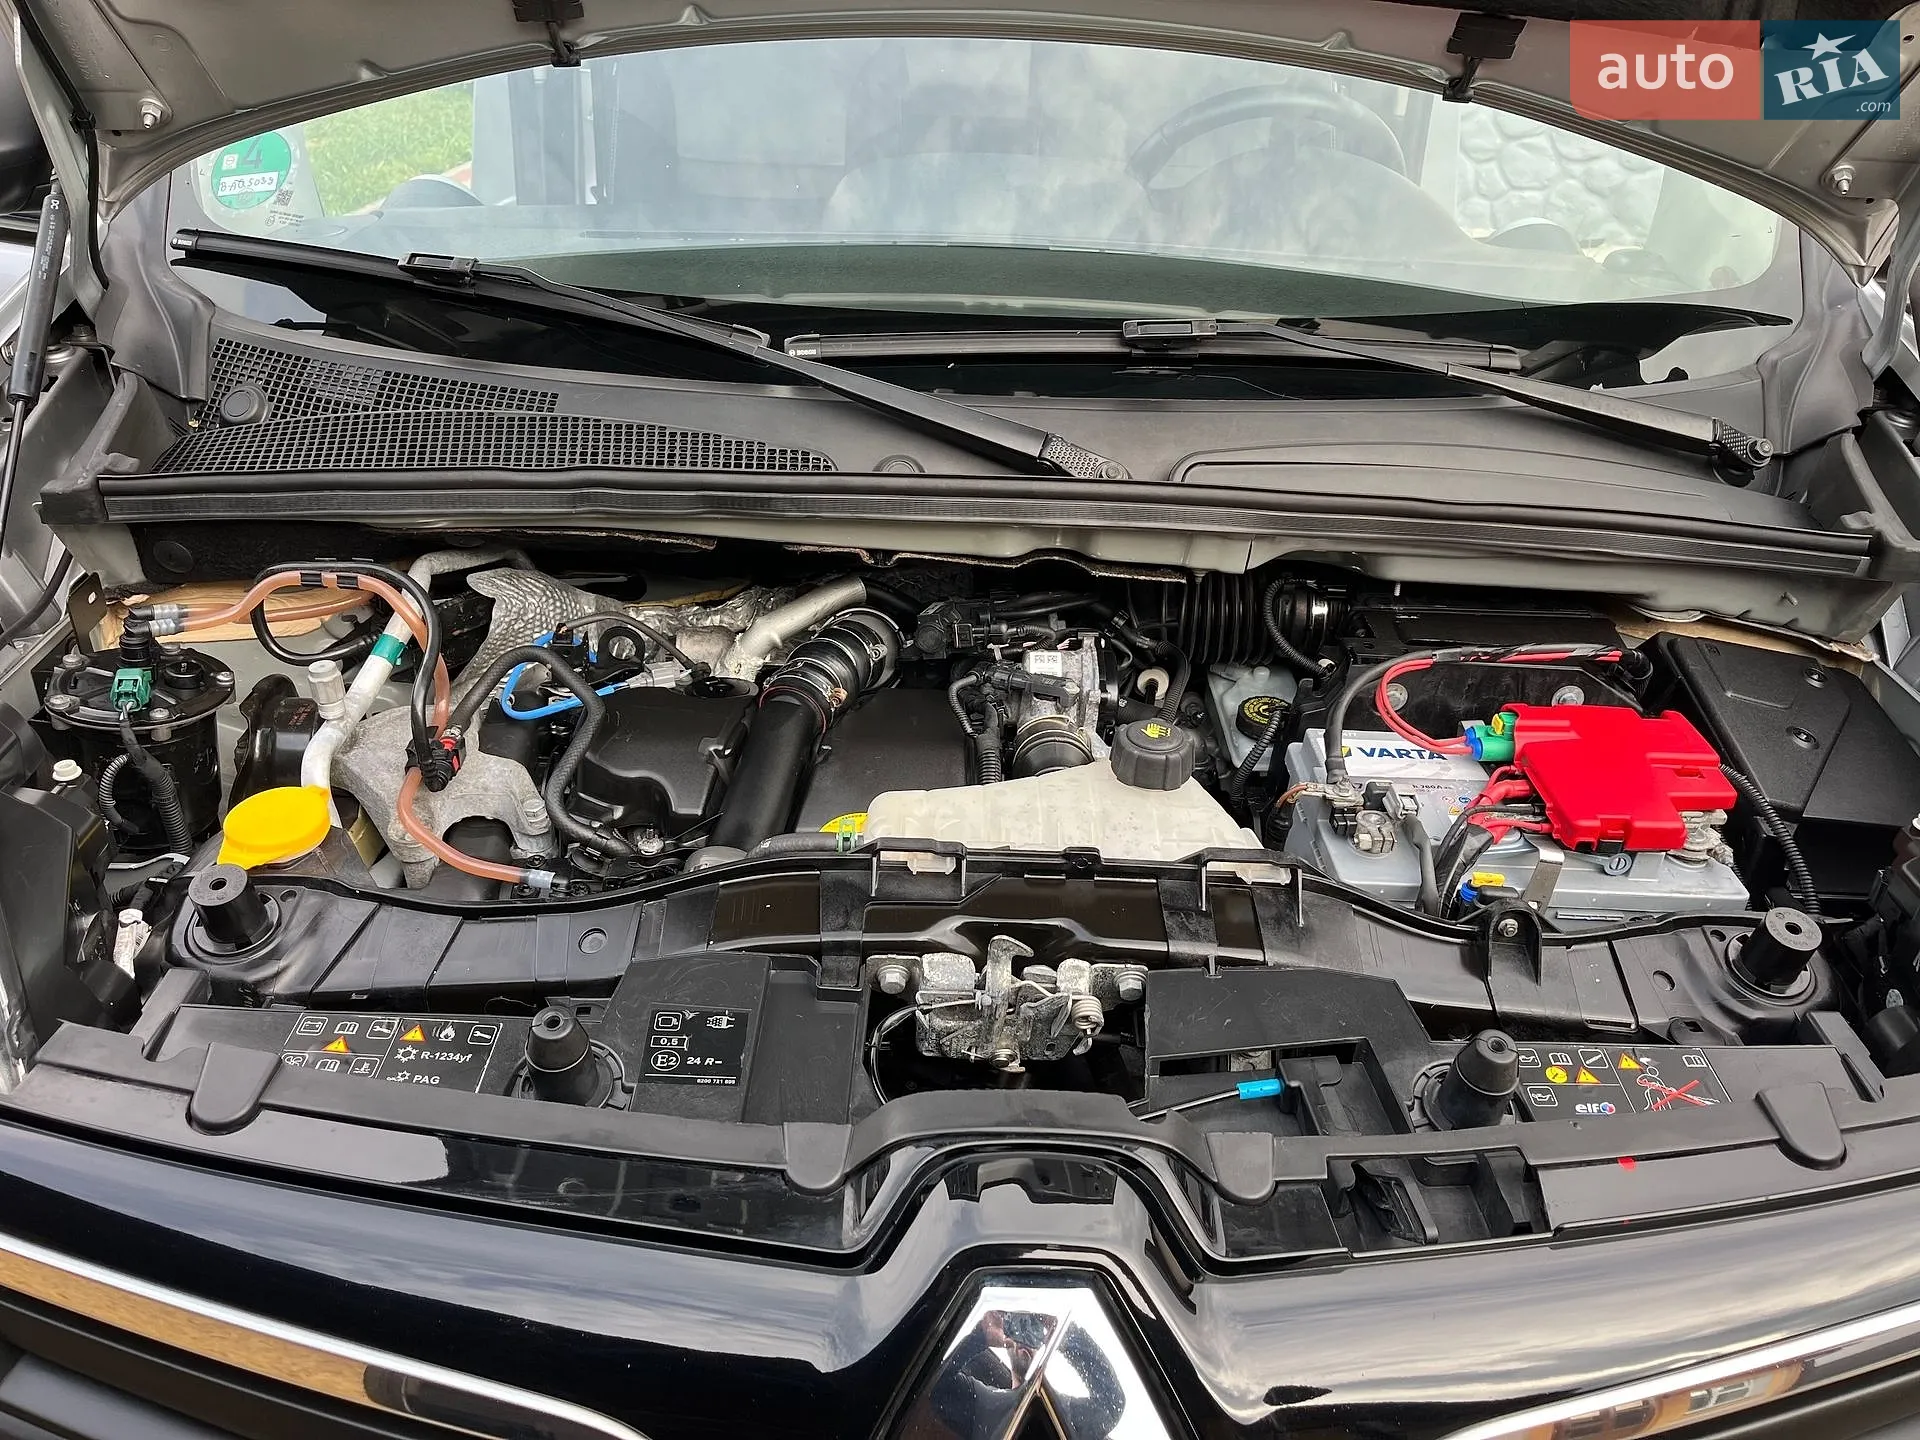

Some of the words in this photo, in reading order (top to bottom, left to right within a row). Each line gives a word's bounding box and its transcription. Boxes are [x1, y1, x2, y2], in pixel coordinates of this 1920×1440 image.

[1357, 746, 1448, 761] VARTA
[420, 1050, 473, 1063] R-1234yf
[656, 1054, 677, 1067] E2
[686, 1056, 702, 1066] 24
[412, 1074, 441, 1086] PAG
